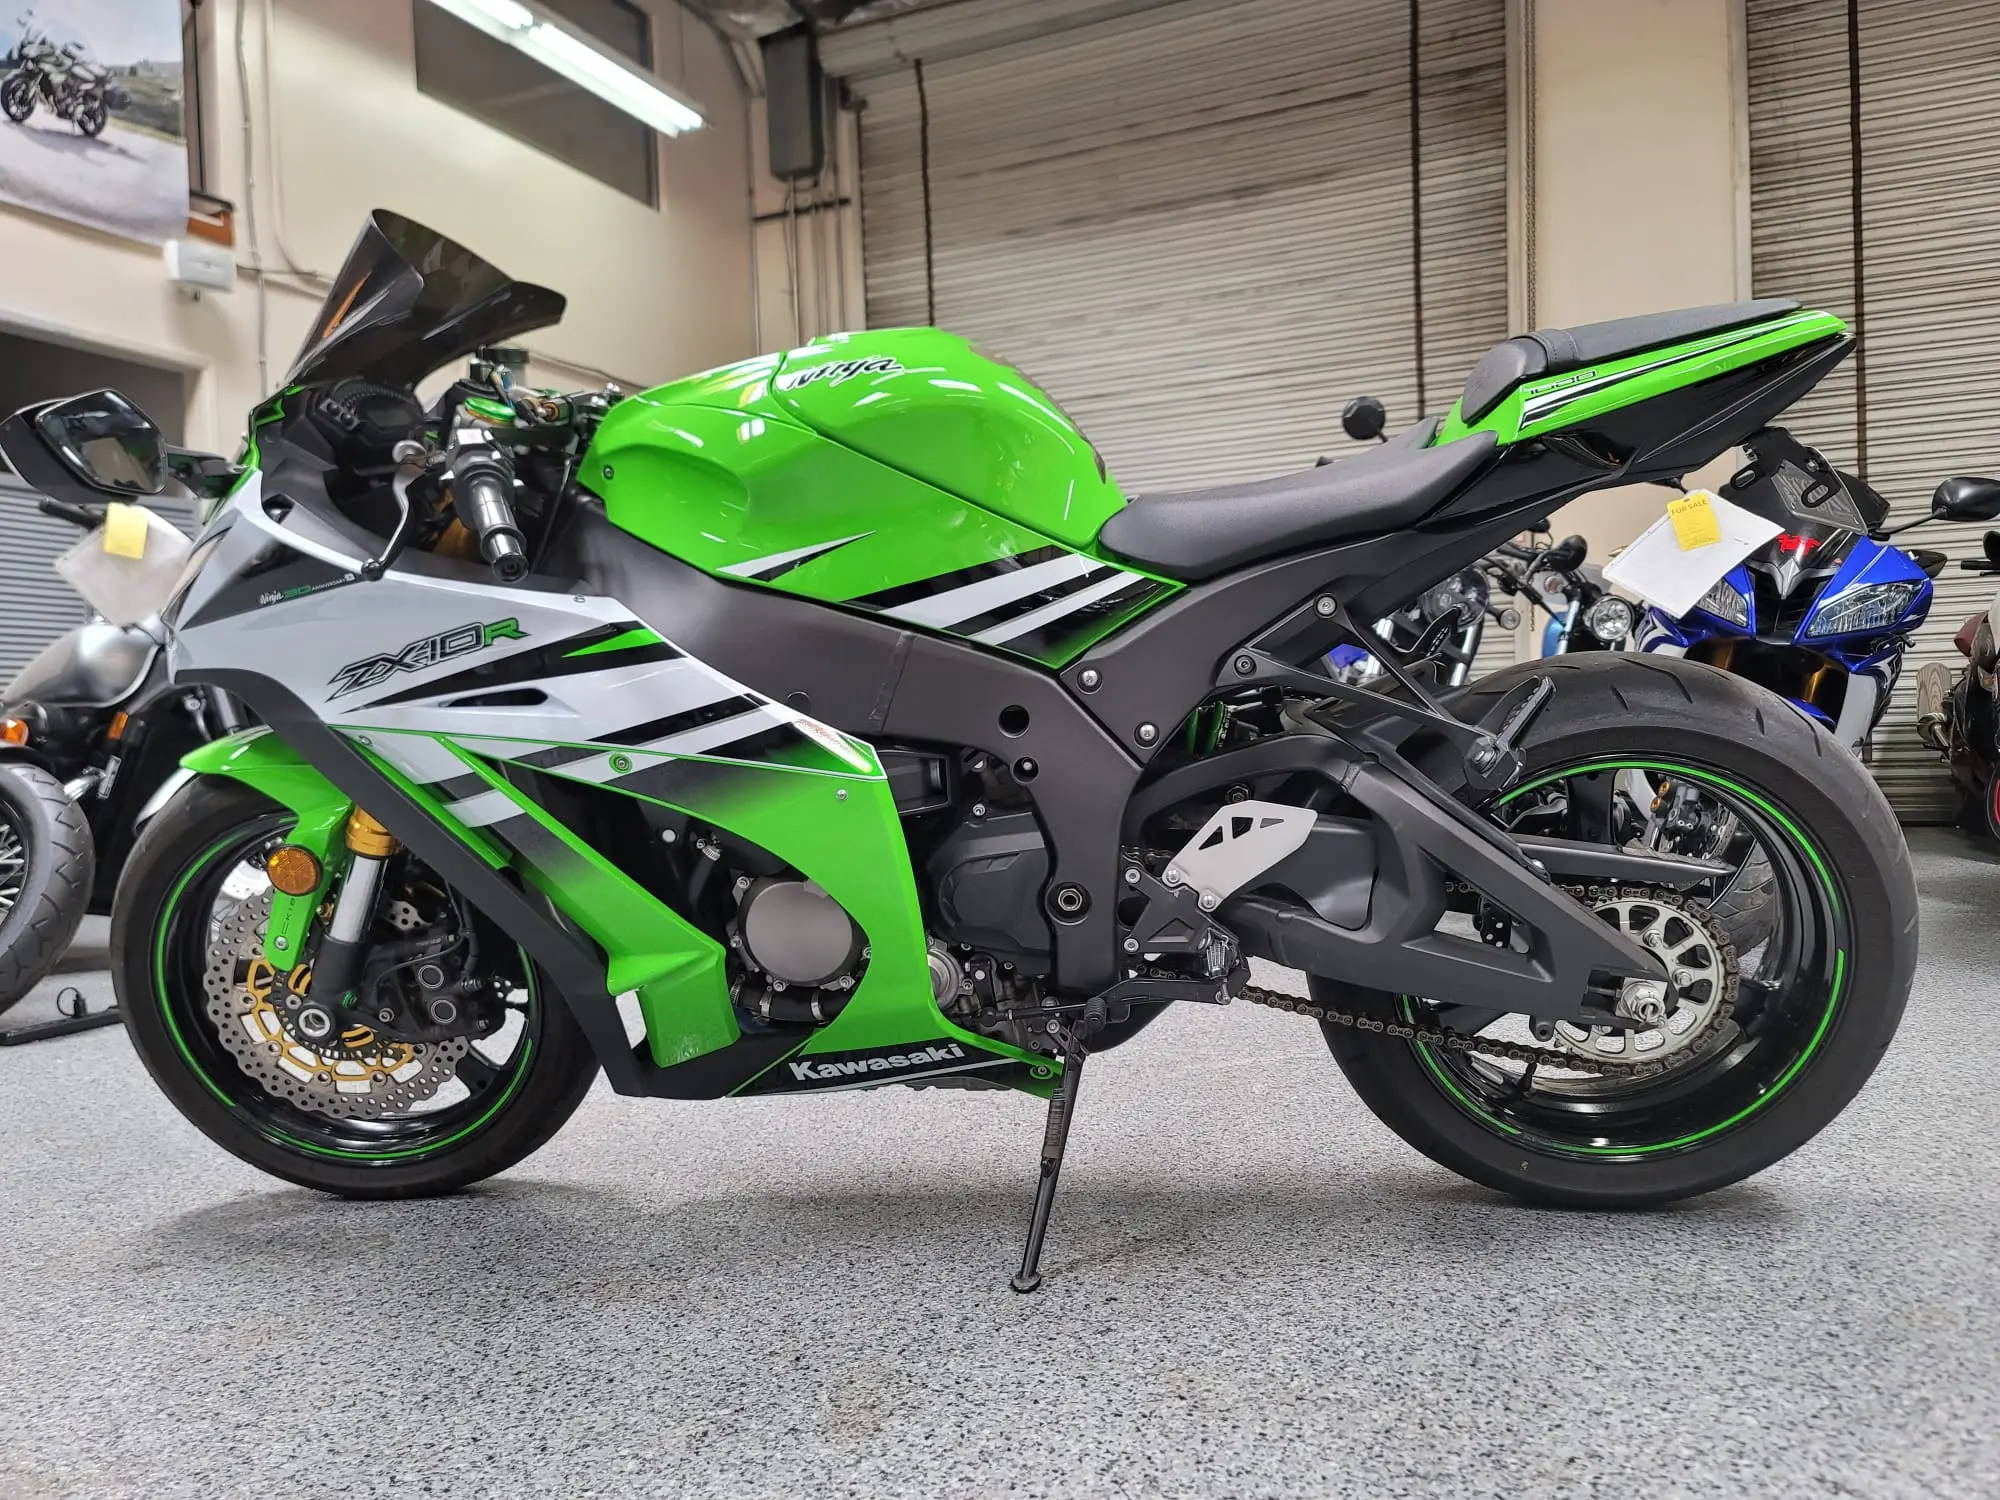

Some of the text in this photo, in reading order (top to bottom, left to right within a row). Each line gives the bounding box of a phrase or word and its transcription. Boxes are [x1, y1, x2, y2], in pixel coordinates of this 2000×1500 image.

[778, 355, 904, 390] Ninja
[1671, 499, 1708, 516] FOR SALE
[788, 1043, 965, 1081] Kawasaki
